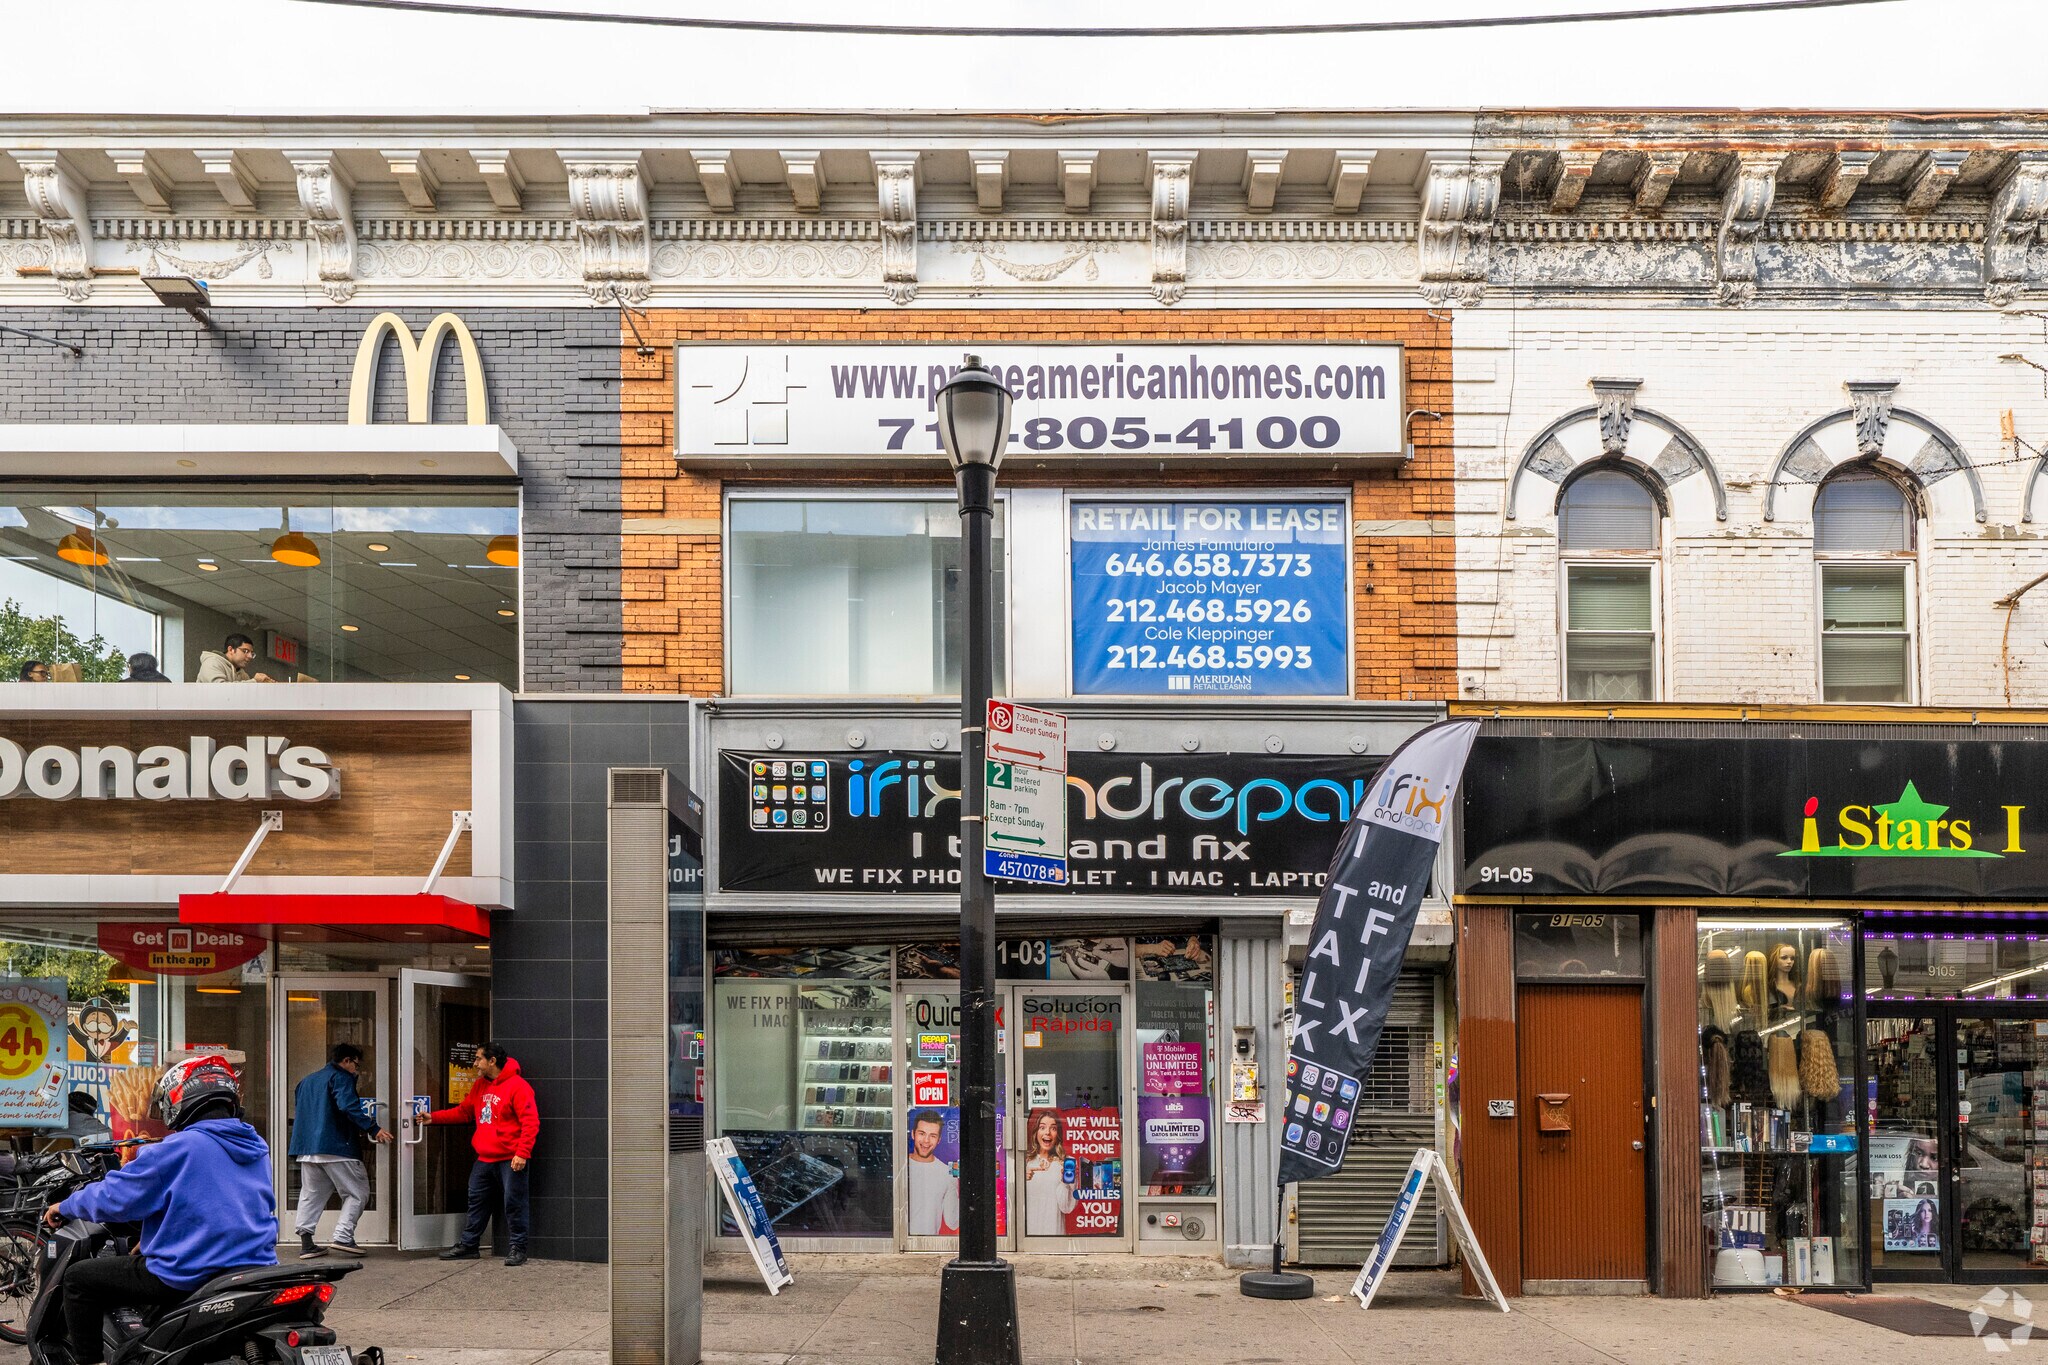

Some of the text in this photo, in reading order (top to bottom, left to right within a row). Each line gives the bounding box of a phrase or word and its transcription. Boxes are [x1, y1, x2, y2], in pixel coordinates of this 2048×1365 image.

[831, 353, 1385, 412] www.peamericanhomes.com
[1078, 508, 1338, 532] RETAIL FOR LEASE
[1142, 538, 1274, 551] James Famularo
[1105, 553, 1312, 577] 646.658.7373
[1156, 580, 1262, 597] Jacob Mayer
[1106, 599, 1312, 622] 212.468.5926
[1144, 626, 1274, 643] Cole Kleppinger
[274, 634, 298, 662] EXIT
[1107, 645, 1312, 670] 212.468.5993
[1194, 675, 1252, 684] MERIDIAN
[1016, 713, 1058, 728] 7:30am 8am
[1016, 724, 1060, 740] Except Sunday
[992, 762, 1005, 786] 2
[1014, 767, 1028, 776] hour
[1014, 776, 1040, 786] metered
[1014, 785, 1038, 795] parking
[1378, 768, 1446, 824] ifix
[990, 800, 1030, 814] 8am 7pm
[990, 813, 1044, 830] Except Sunday
[1374, 808, 1440, 834] andrepair
[1838, 804, 1972, 853] Stars
[913, 832, 922, 858] I
[1069, 834, 1166, 860] and
[1193, 834, 1250, 861] fix
[1353, 824, 1370, 858] I
[815, 868, 853, 884] WE
[862, 868, 902, 884] FIX
[1152, 872, 1157, 885] I
[1168, 872, 1223, 886] MAC
[999, 860, 1046, 880] 457078
[1480, 866, 1534, 883] 91-05
[1368, 880, 1408, 905] and
[132, 932, 244, 946] Get Deals
[152, 954, 210, 968] in the app
[1928, 966, 1956, 977] 9105
[18, 986, 66, 1018] OPEN!
[727, 997, 746, 1009] WE
[751, 997, 771, 1009] FIX
[762, 1015, 789, 1027] MAC
[1303, 1071, 1316, 1082] 26
[920, 1087, 943, 1100] OPEN
[4, 1097, 60, 1108] and mobile
[24, 1108, 64, 1120] instore!
[1066, 1117, 1119, 1127] WE WILL
[1066, 1130, 1120, 1141] FIX YOUR
[1072, 1144, 1114, 1154] PHONE
[1078, 1189, 1120, 1200] WHILES
[1082, 1203, 1112, 1214] YOU
[1076, 1216, 1118, 1228] SHOP!
